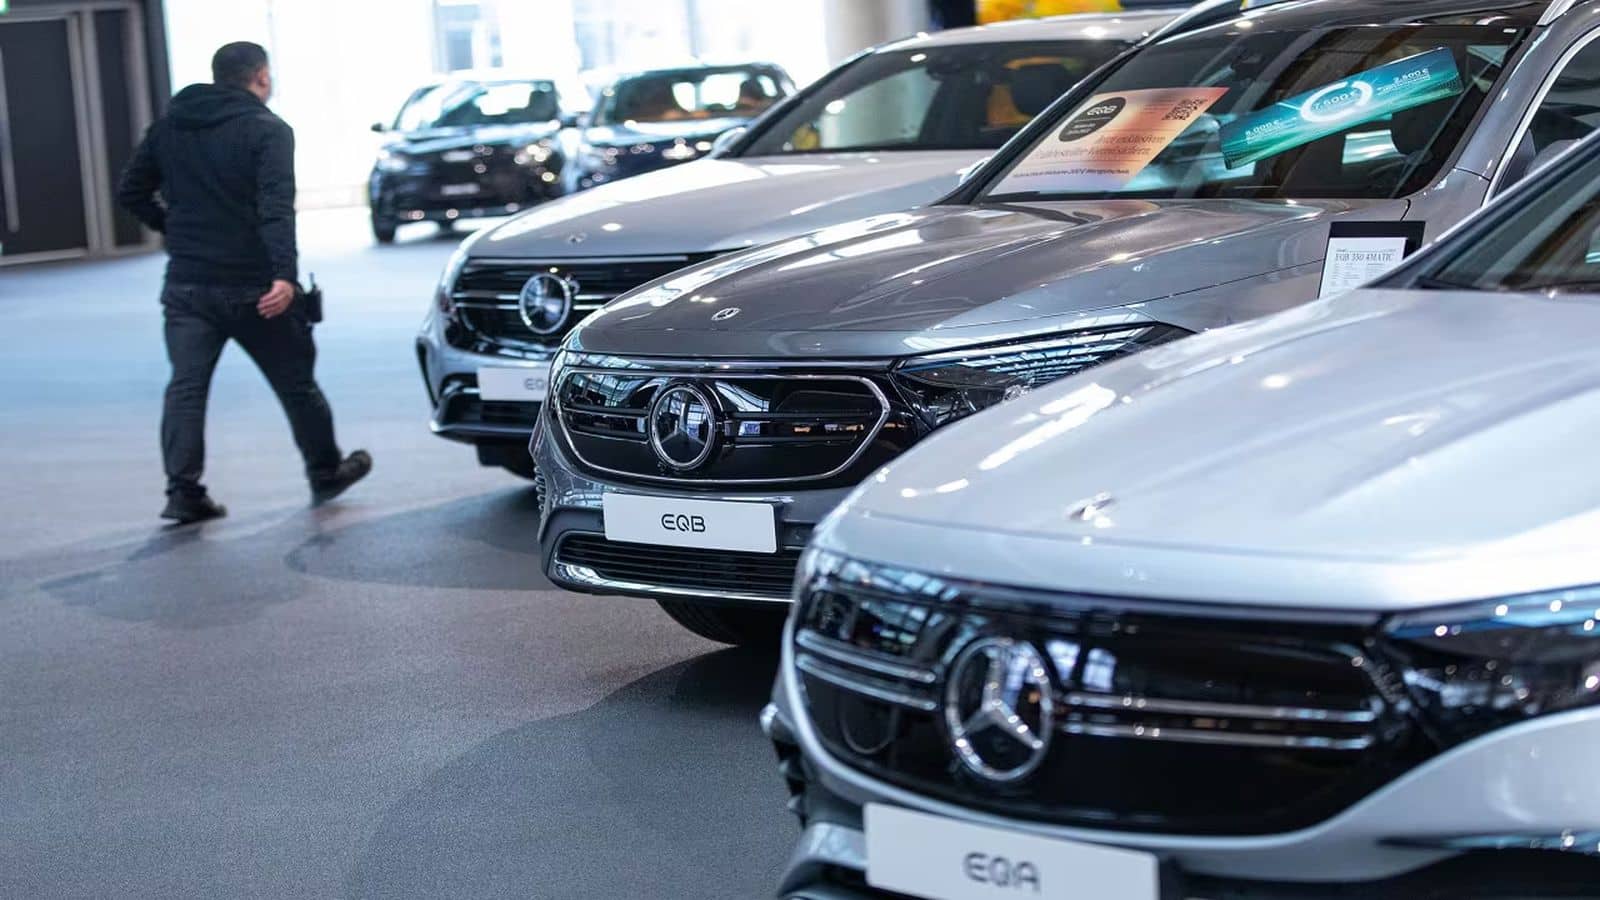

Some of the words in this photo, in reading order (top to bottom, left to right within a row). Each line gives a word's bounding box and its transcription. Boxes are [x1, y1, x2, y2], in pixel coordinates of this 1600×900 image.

[524, 378, 548, 391] EQ
[661, 513, 706, 533] EQB
[963, 852, 1041, 893] EQA
